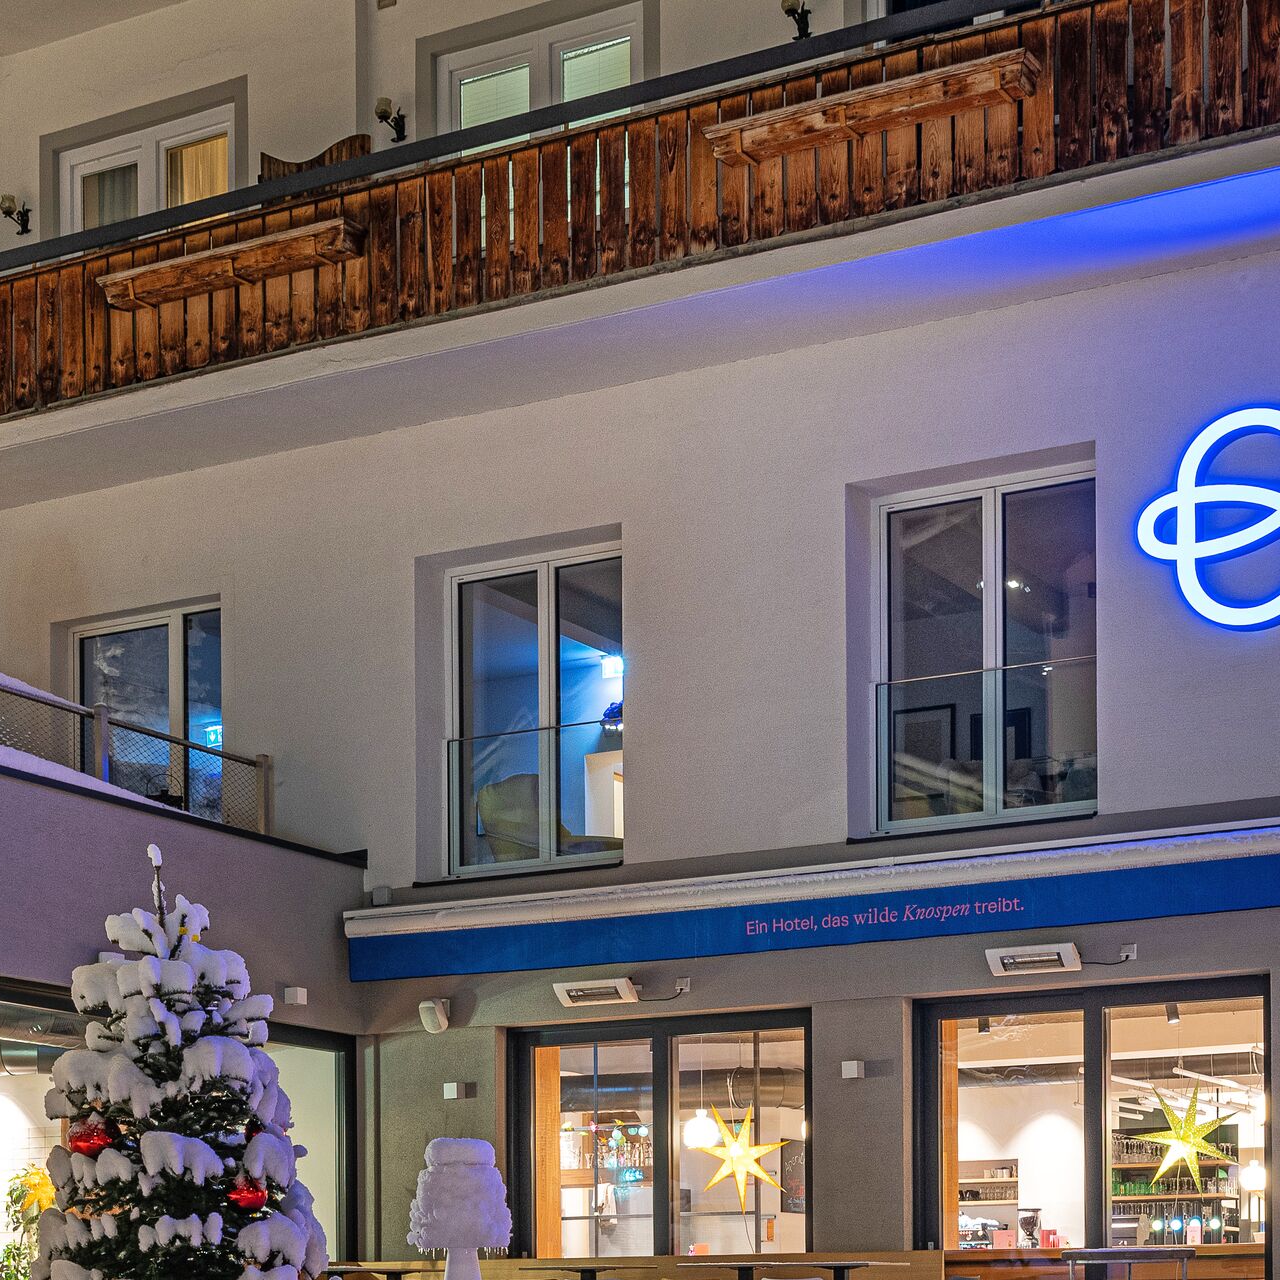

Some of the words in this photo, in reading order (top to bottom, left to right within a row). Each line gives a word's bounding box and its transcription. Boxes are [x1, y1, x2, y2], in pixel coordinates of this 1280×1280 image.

[746, 920, 768, 936] Ein
[772, 915, 818, 933] Hotel,
[821, 913, 849, 929] das
[853, 906, 898, 926] wilde
[902, 903, 971, 922] Knospen
[973, 897, 1025, 915] treibt.
